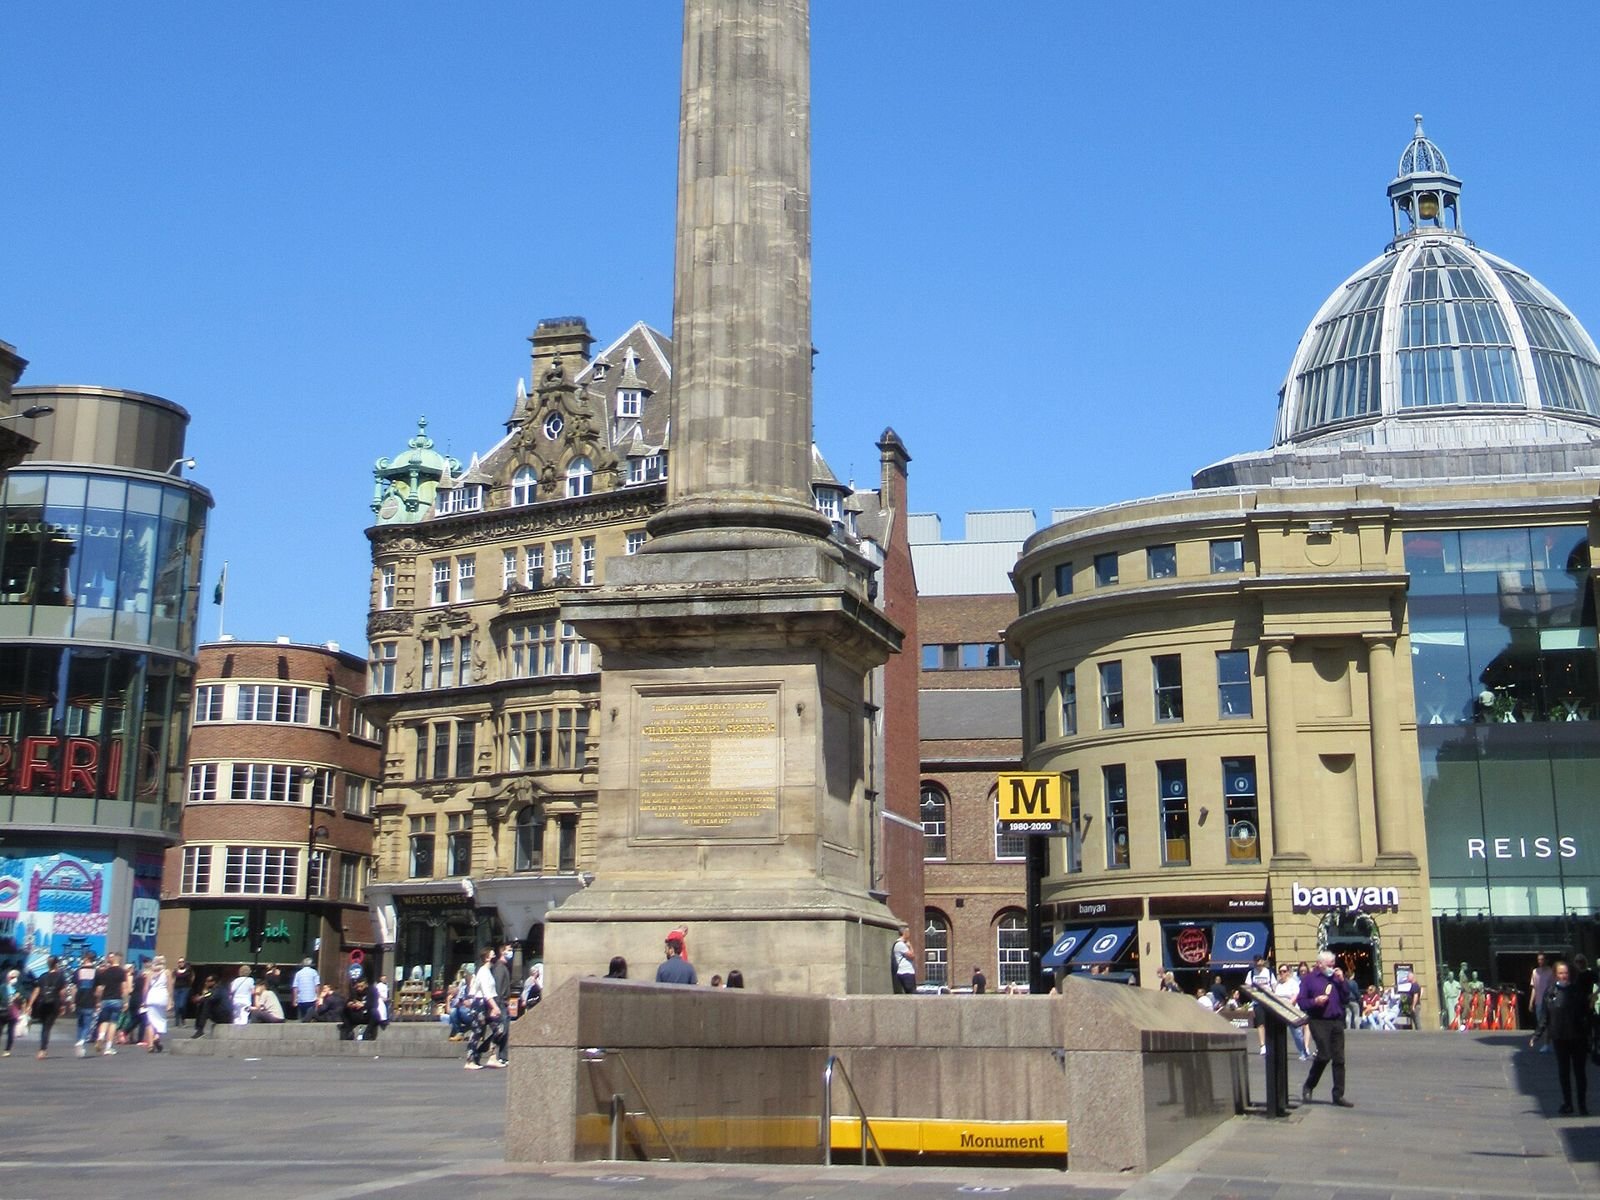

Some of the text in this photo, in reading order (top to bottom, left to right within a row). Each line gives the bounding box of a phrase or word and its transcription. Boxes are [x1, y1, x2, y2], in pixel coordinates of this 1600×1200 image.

[1009, 778, 1051, 815] M
[1009, 822, 1052, 831] 1980-2020
[1467, 836, 1577, 859] REISS
[402, 895, 467, 905] WATERSTONES
[1291, 881, 1400, 913] banyan
[1079, 903, 1107, 915] banyan
[132, 916, 156, 933] AYE
[960, 1134, 1045, 1149] Monument
